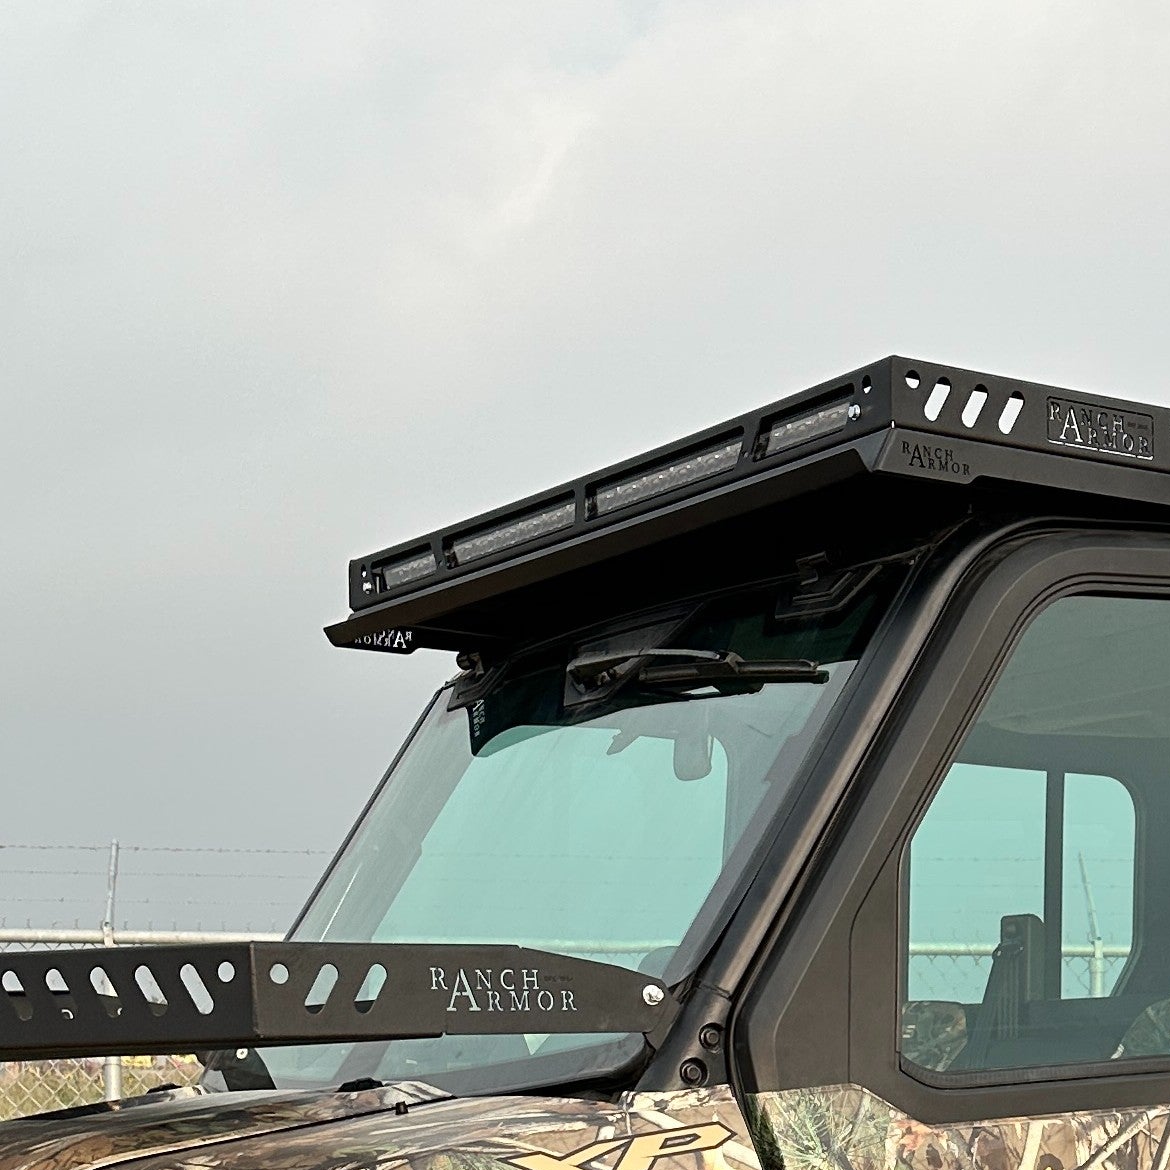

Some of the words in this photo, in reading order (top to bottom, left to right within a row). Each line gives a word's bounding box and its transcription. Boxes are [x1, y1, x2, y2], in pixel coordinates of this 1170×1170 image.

[1049, 401, 1124, 443] RANCH
[1059, 406, 1150, 455] ARMOR
[902, 441, 953, 468] RANCH
[908, 443, 970, 476] ARMOR
[446, 968, 578, 1012] ARMOR
